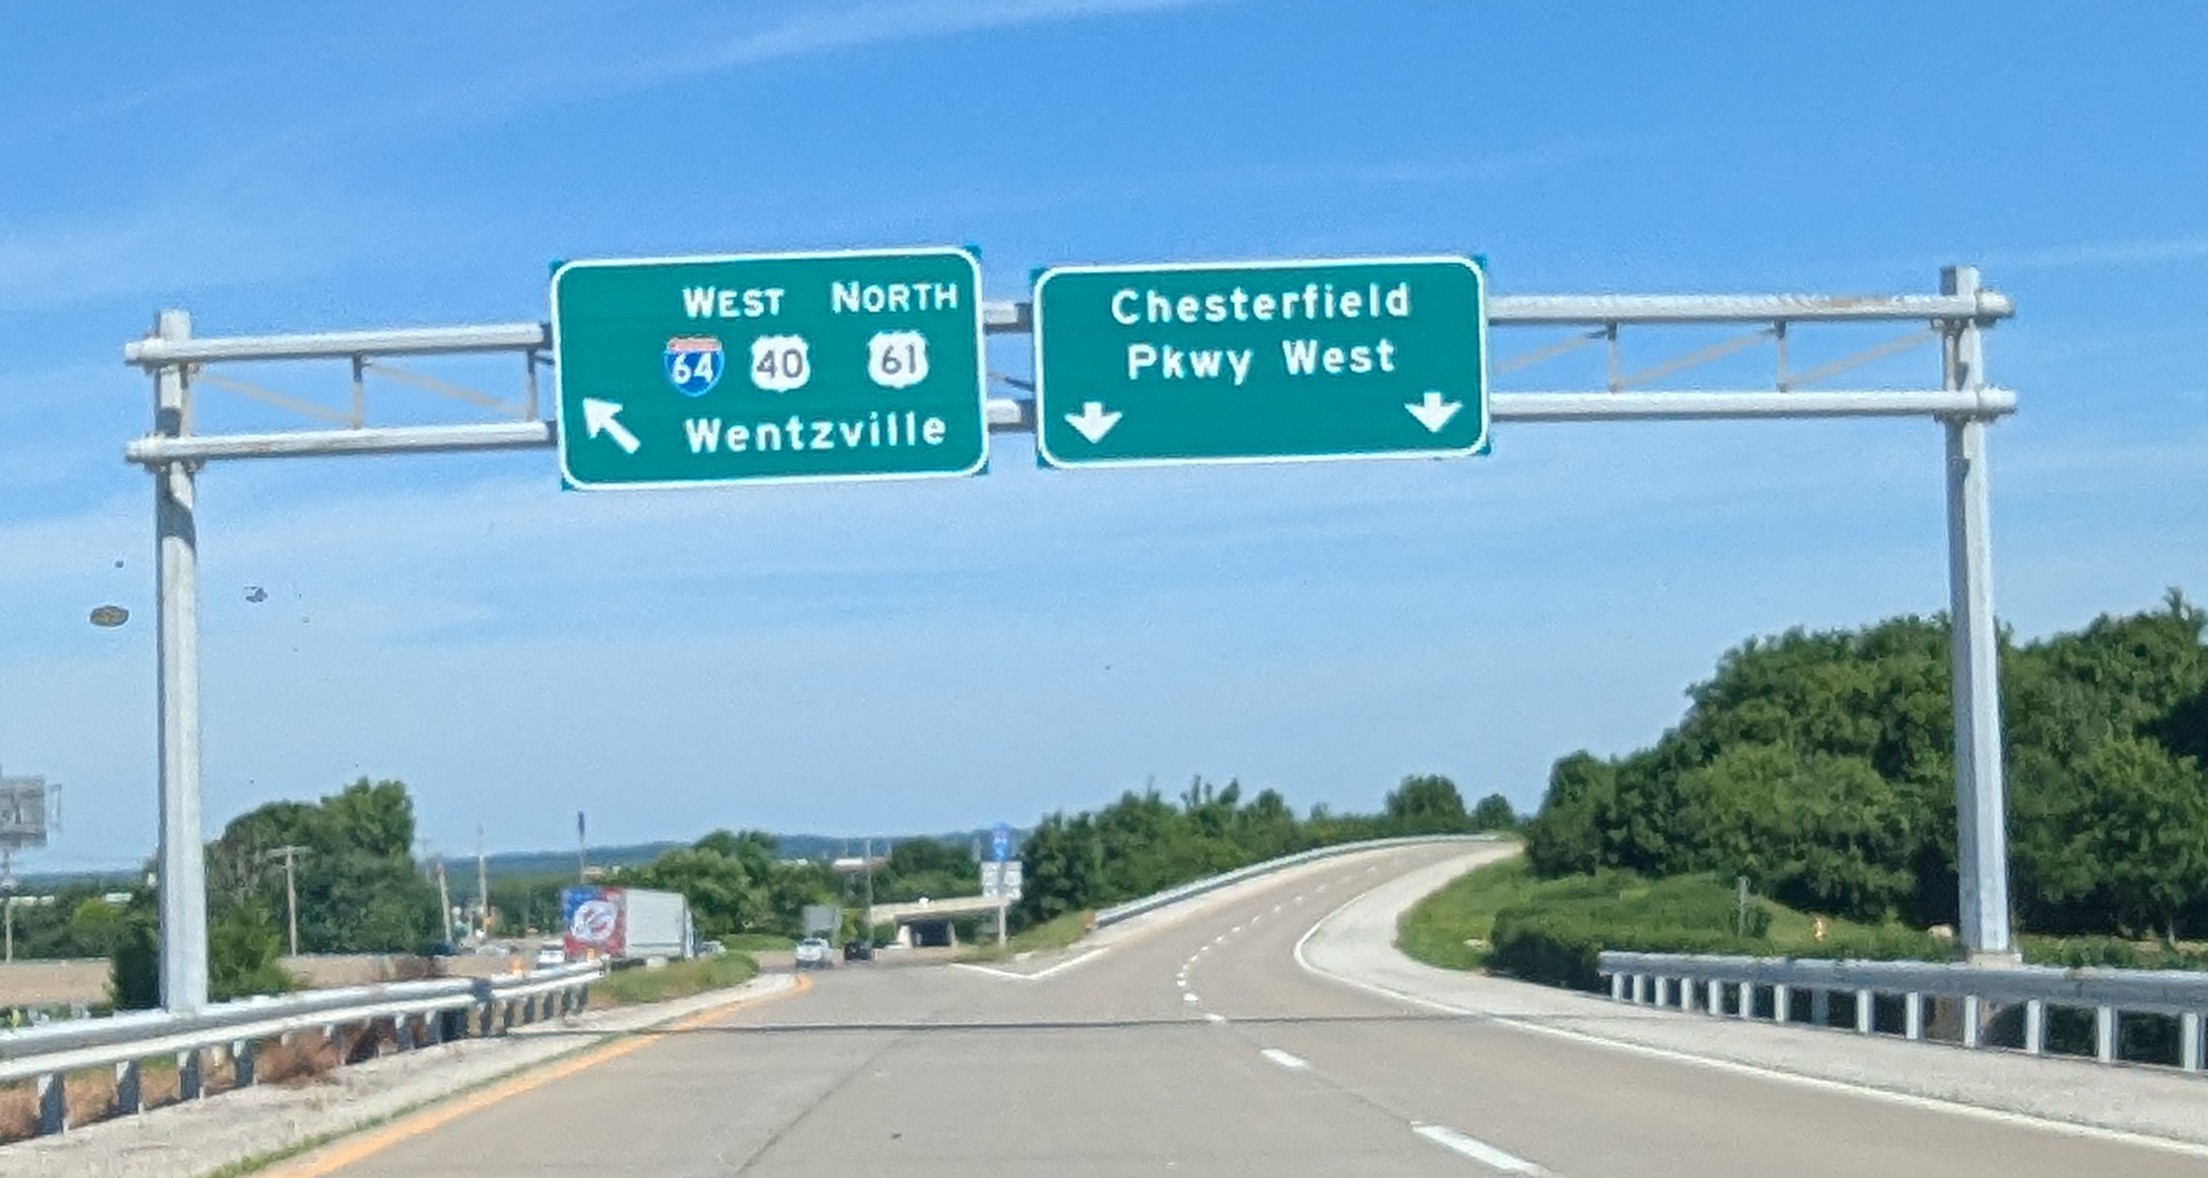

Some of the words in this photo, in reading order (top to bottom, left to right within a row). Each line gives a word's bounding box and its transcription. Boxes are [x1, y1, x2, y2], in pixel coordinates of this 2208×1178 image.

[683, 286, 785, 318] WEST
[831, 281, 958, 314] NORTH
[1111, 282, 1411, 324] Chesterfield
[672, 354, 714, 383] 64
[756, 348, 804, 379] 40
[881, 344, 917, 375] 61
[1127, 343, 1252, 385] Pkwy
[1282, 338, 1395, 375] West
[684, 411, 947, 453] Wentzville
